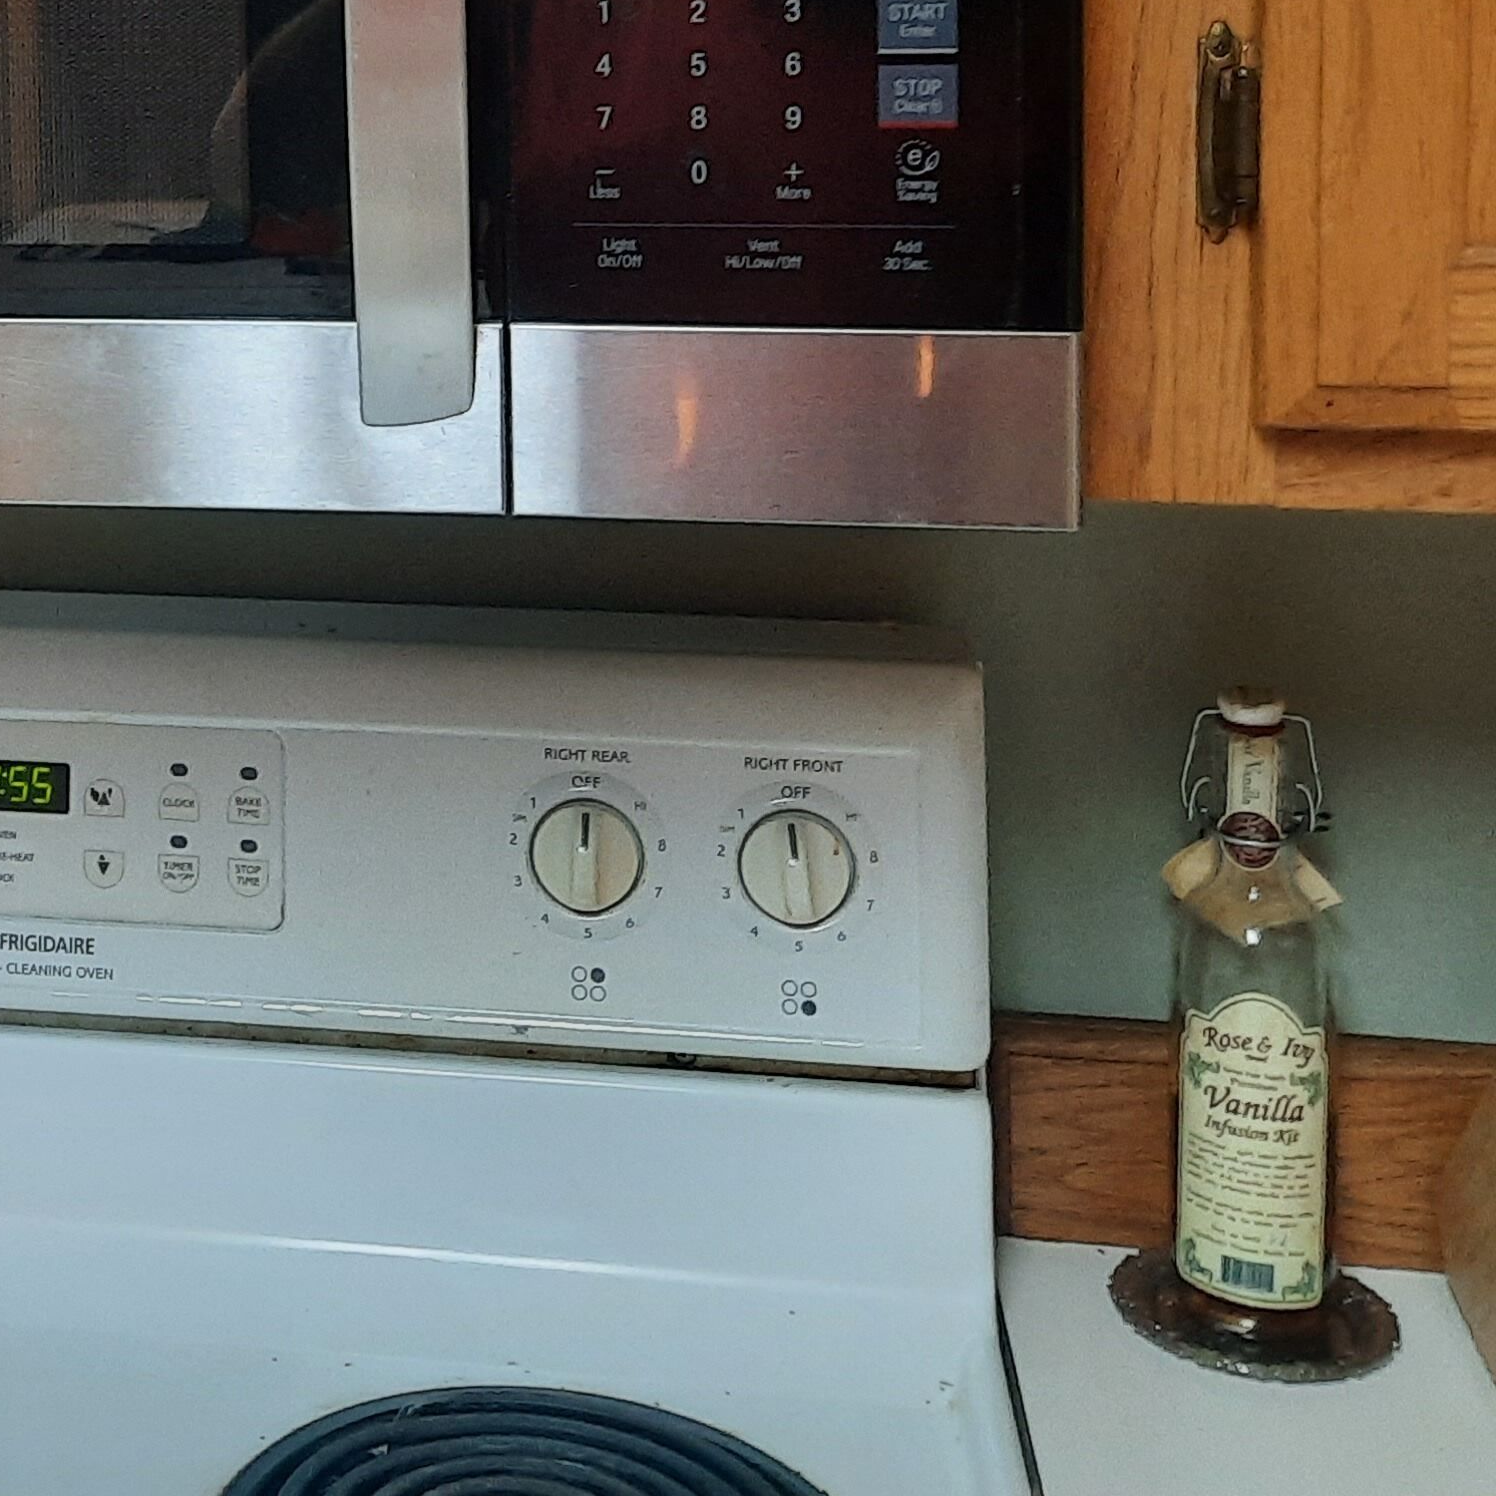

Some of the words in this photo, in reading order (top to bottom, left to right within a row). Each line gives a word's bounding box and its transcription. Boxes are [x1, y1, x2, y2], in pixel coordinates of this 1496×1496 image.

[596, 0, 610, 24] 1
[689, 0, 707, 23] 2
[888, 3, 949, 22] START
[595, 53, 612, 77] 4
[690, 52, 707, 76] 5
[785, 52, 801, 76] 6
[893, 79, 943, 96] STOP
[596, 106, 612, 130] 7
[690, 106, 707, 130] 8
[785, 106, 802, 130] 9
[690, 160, 708, 184] 0
[589, 184, 621, 199] Less
[775, 185, 812, 199] More
[603, 239, 637, 253] Light
[747, 240, 780, 253] Vent
[895, 241, 922, 254] Add
[544, 747, 587, 762] RIGHT
[591, 750, 631, 764] REAR
[744, 756, 789, 771] RIGHT
[793, 758, 844, 773] FRONT
[571, 775, 601, 789] OFF
[780, 785, 811, 799] OFF
[162, 797, 195, 808] CLOCK
[509, 832, 518, 846] 2
[657, 838, 666, 852] 8
[717, 844, 726, 857] 2
[869, 850, 879, 863] 8
[235, 864, 261, 874] STOP
[514, 875, 522, 887] 3
[654, 886, 663, 898] 7
[722, 887, 730, 900] 3
[866, 899, 875, 911] 7
[540, 912, 549, 924] 4
[625, 917, 635, 929] 6
[584, 927, 592, 939] 5
[750, 925, 758, 937] 4
[837, 931, 846, 942] 6
[0, 933, 95, 955] FRIGIDAIRE
[795, 940, 803, 952] 5
[6, 962, 72, 978] CLEANING
[76, 966, 114, 980] OVEN
[1203, 1026, 1253, 1052] Rose
[1256, 1036, 1272, 1053] &
[1282, 1037, 1315, 1068] Ivy
[1204, 1085, 1304, 1123] Vanilla
[1205, 1114, 1269, 1141] Infusion
[1272, 1128, 1300, 1146] Kit
